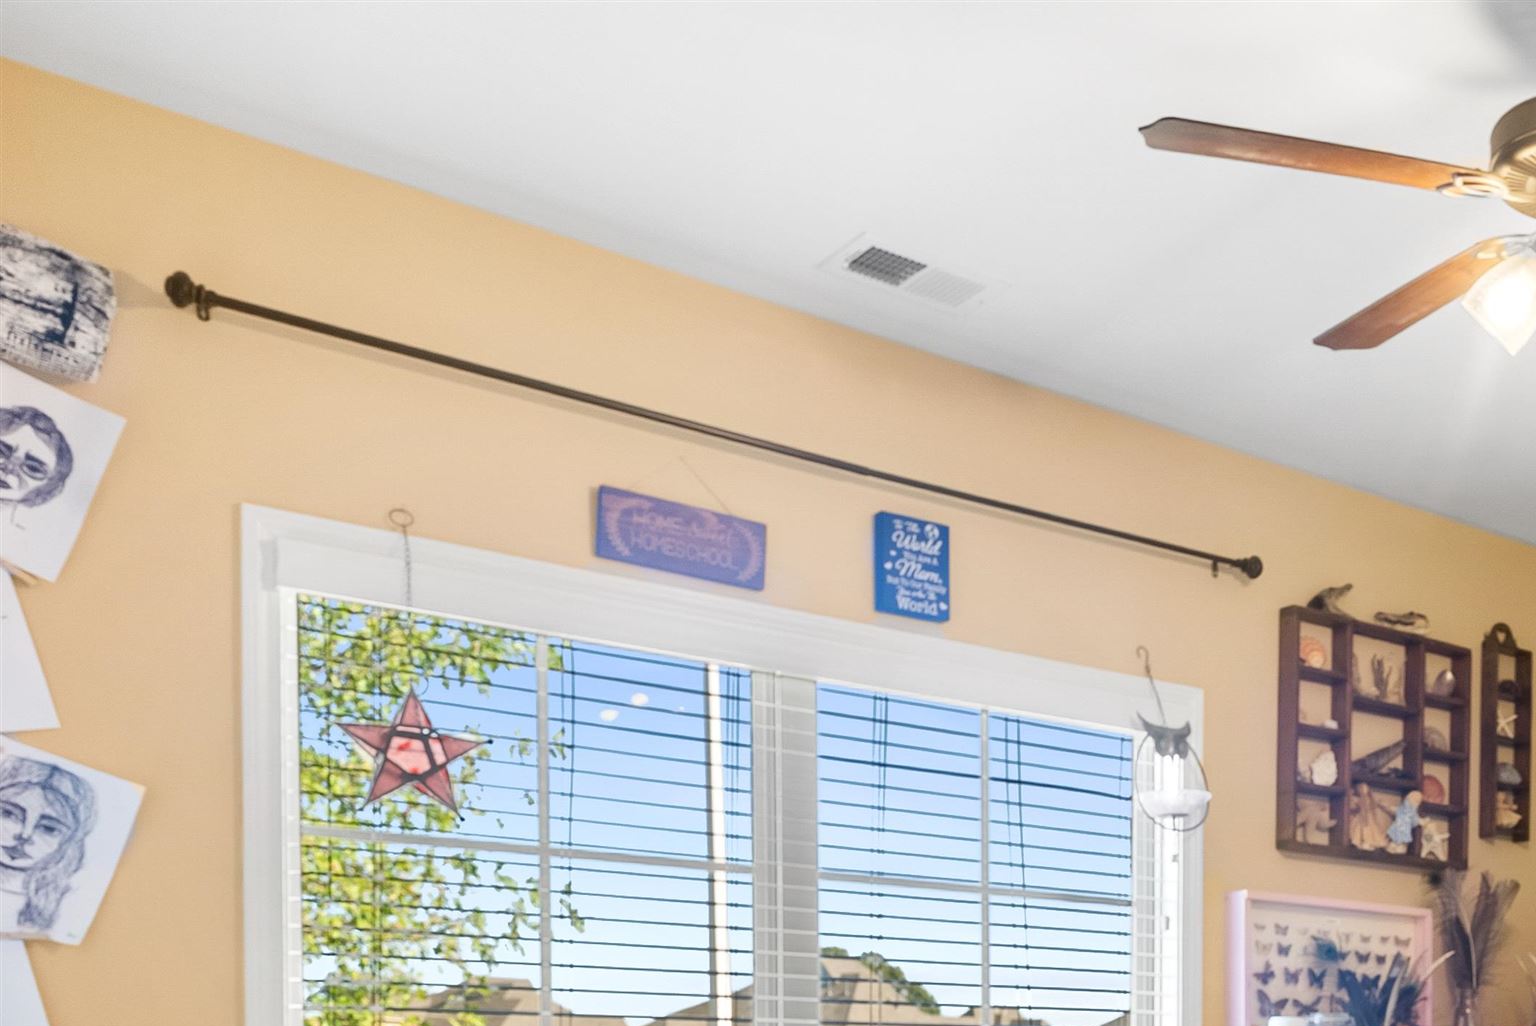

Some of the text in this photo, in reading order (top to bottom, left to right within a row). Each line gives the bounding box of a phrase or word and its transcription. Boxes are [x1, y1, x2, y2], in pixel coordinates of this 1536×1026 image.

[632, 509, 684, 530] HOME
[630, 529, 739, 571] HOMESCHOOL
[891, 530, 943, 556] World
